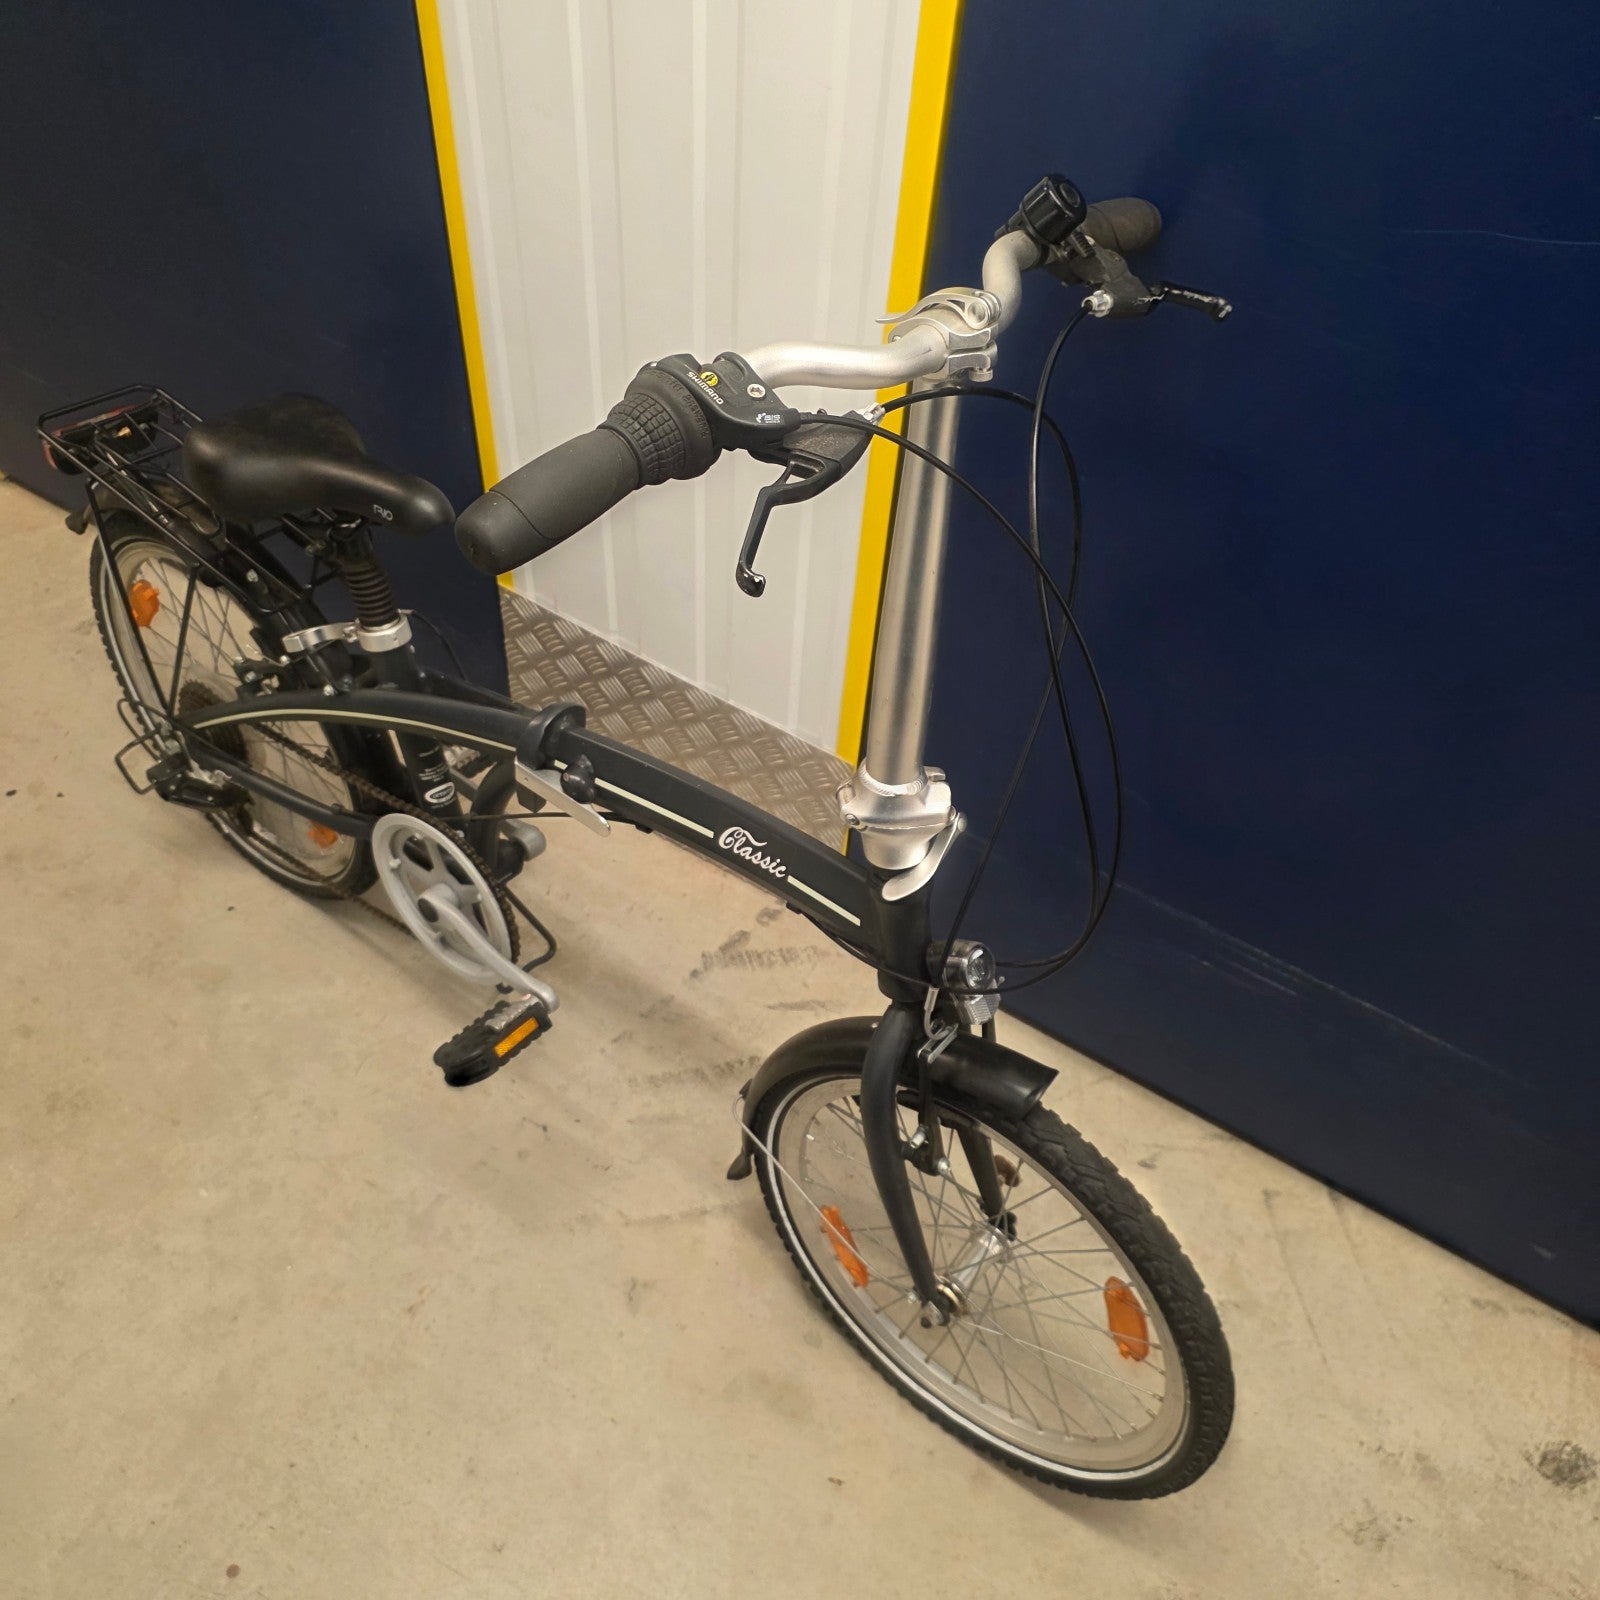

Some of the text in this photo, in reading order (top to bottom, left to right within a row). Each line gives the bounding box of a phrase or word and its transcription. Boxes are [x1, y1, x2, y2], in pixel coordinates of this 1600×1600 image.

[686, 371, 724, 405] SHIMANO
[373, 504, 394, 521] RIO
[718, 826, 788, 878] Classic
